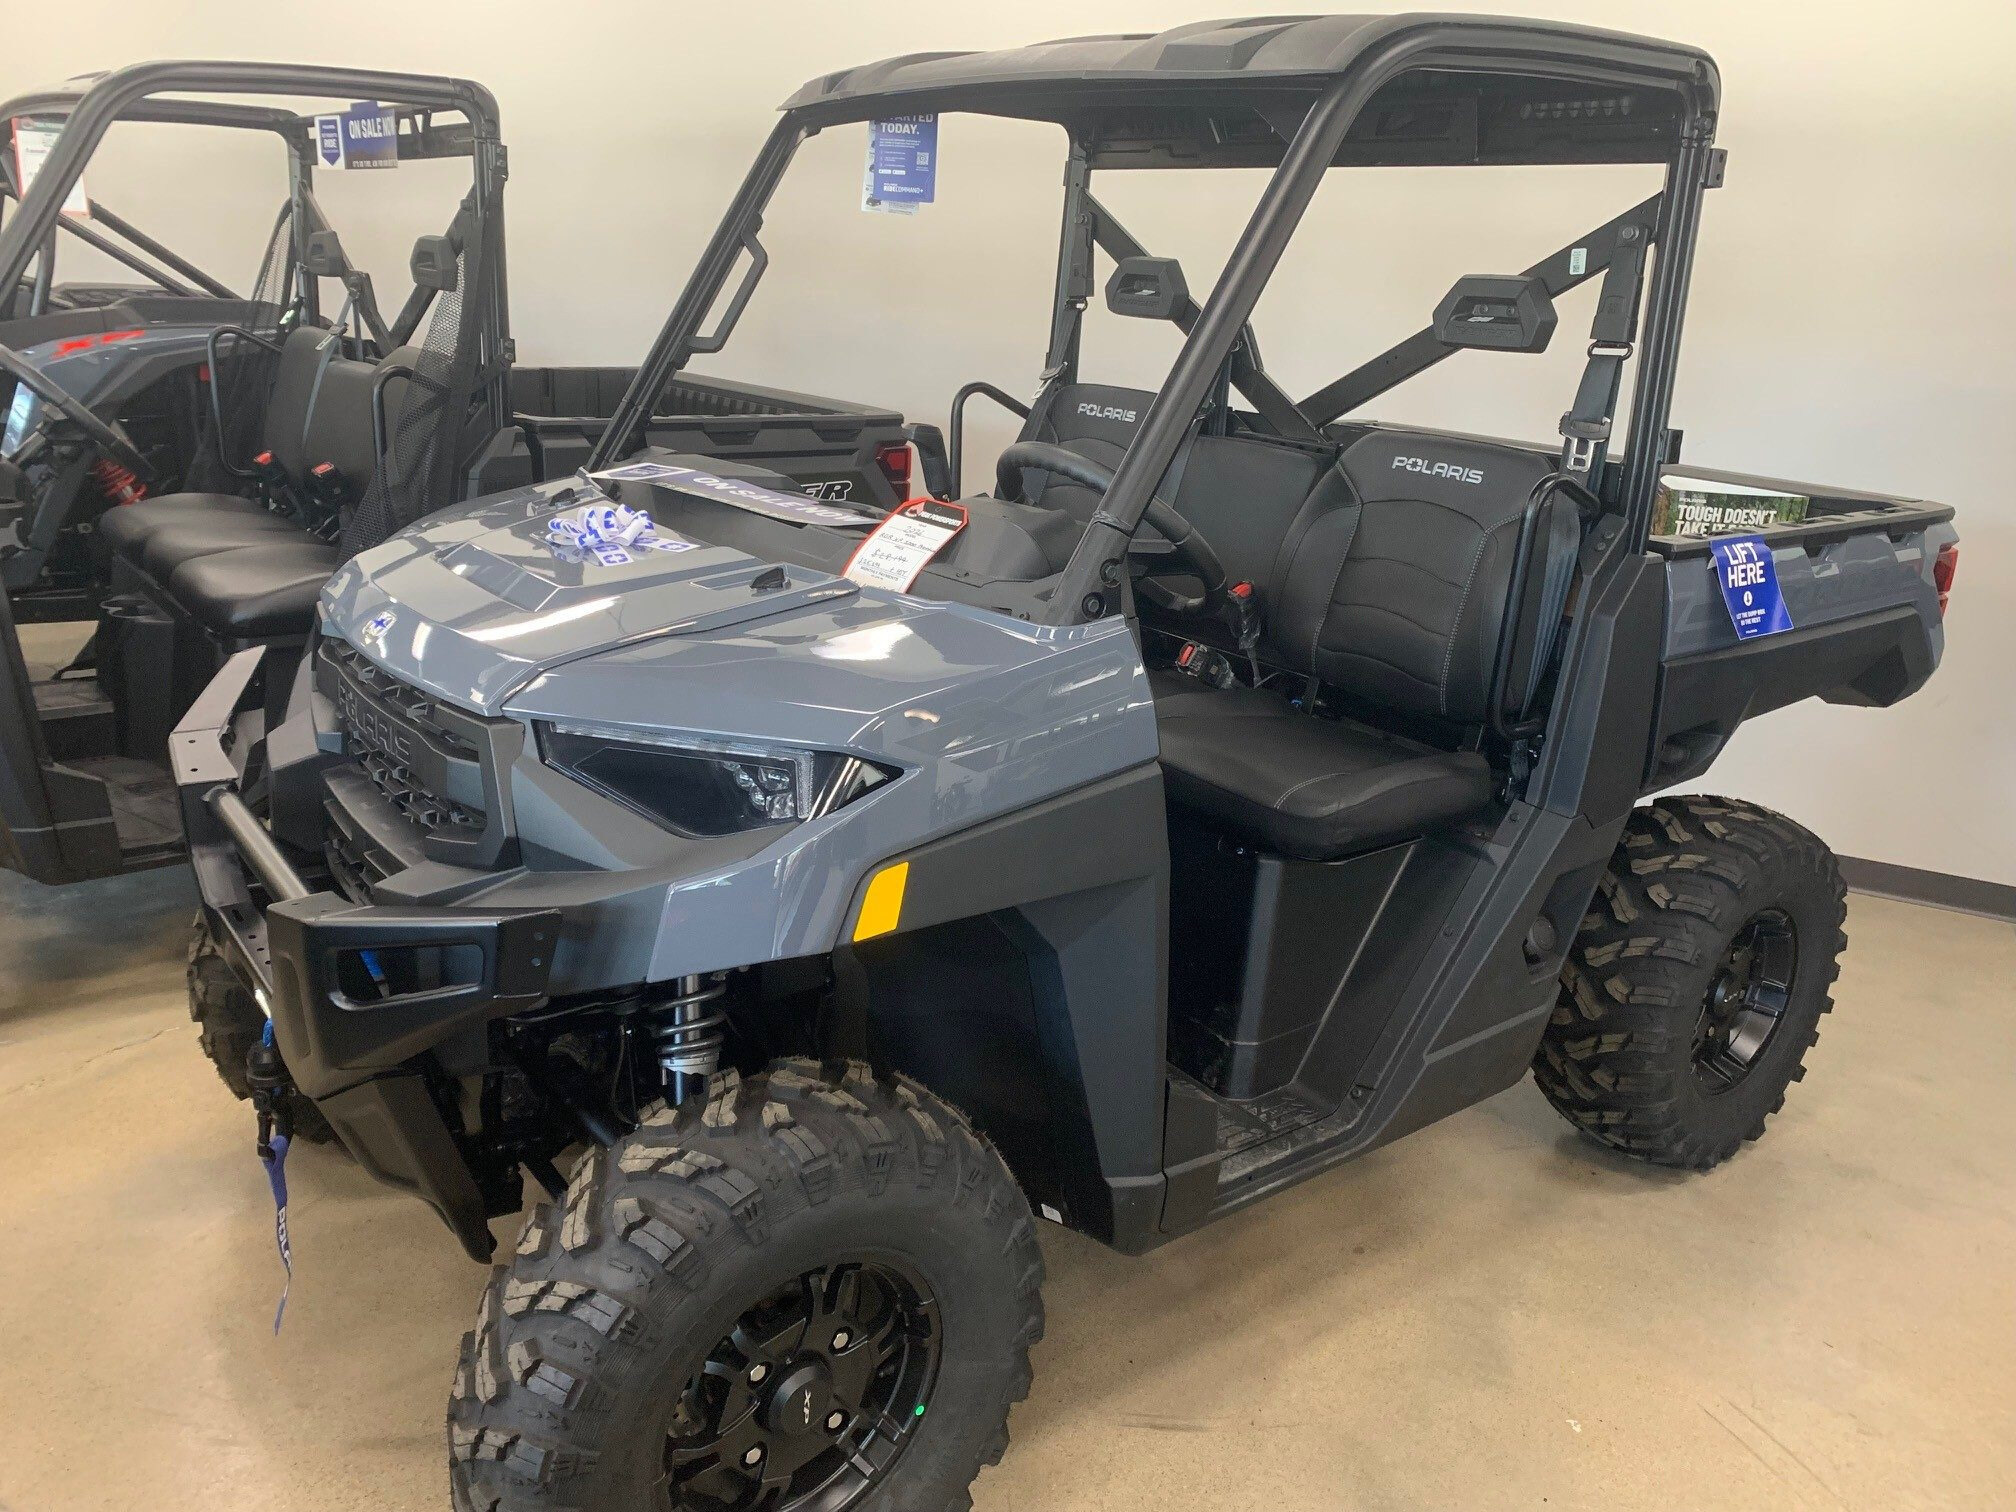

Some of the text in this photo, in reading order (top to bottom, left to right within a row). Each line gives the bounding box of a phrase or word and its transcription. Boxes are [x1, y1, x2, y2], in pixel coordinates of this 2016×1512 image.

[349, 120, 361, 139] ON
[361, 117, 382, 138] SALE
[880, 122, 920, 135] TODAY.
[1077, 402, 1137, 423] POLARIS
[1391, 456, 1484, 484] POLARIS
[692, 476, 738, 491] ON
[731, 490, 797, 509] SALE
[1677, 504, 1778, 525] TOUGH DOESN'T
[1674, 520, 1710, 537] TAKE
[1723, 542, 1758, 566] LIFT
[1727, 561, 1766, 589] HERE
[803, 1389, 811, 1424] XP
